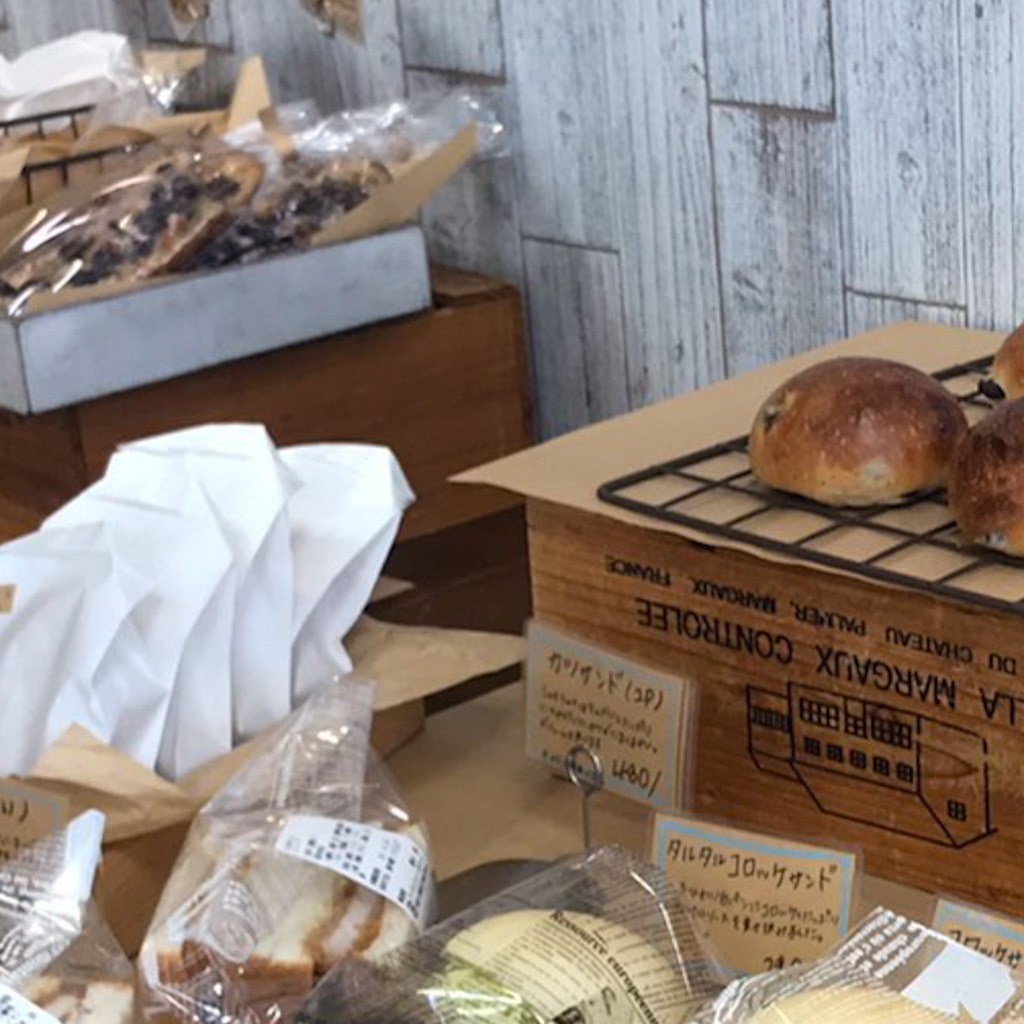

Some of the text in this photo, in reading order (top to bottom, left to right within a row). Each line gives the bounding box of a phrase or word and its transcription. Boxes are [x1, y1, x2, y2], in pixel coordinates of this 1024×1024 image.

[604, 555, 672, 586] FRANCE
[635, 598, 794, 666] CONTROLEE
[885, 627, 973, 665] CHATEAU
[816, 645, 958, 709] MARGAUX
[988, 652, 1017, 676] DU
